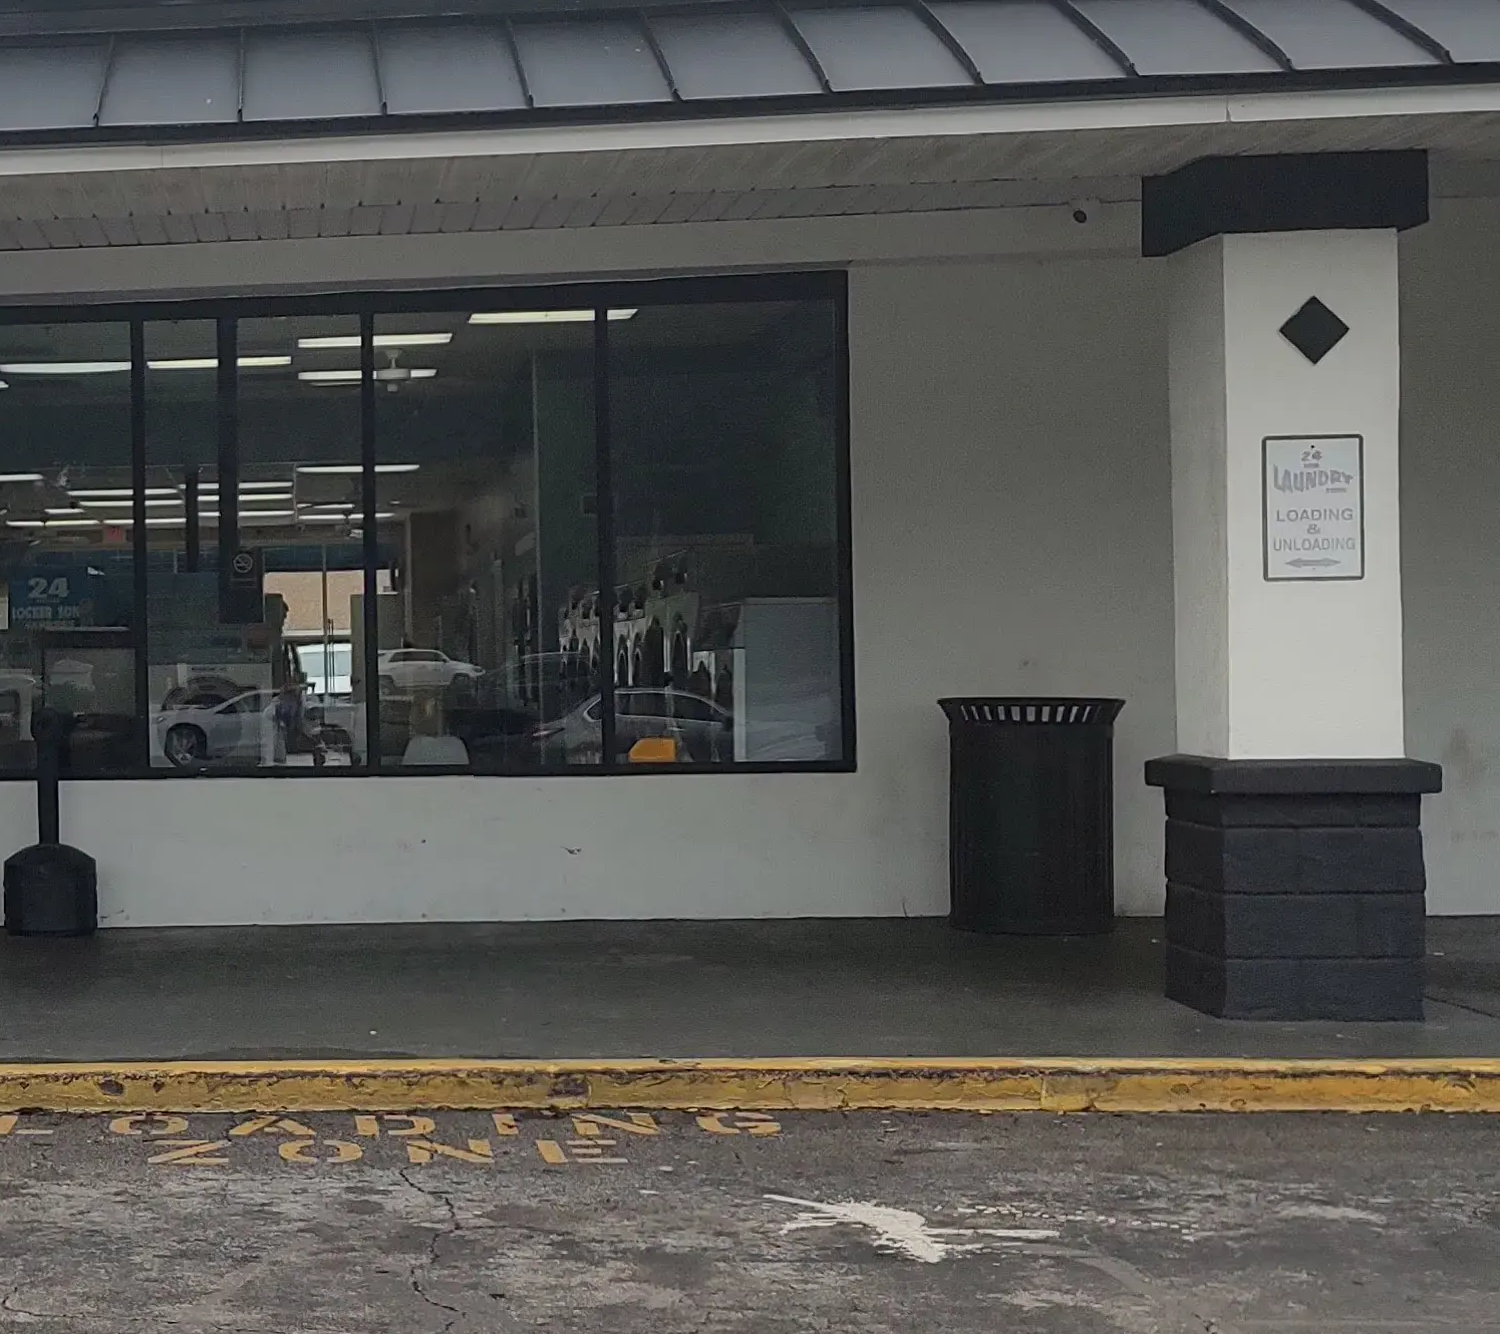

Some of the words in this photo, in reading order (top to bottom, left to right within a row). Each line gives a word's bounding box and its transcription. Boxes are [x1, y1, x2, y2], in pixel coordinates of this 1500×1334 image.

[1301, 450, 1322, 461] 24
[1273, 464, 1355, 493] LAUNDRY
[1276, 508, 1353, 522] LOADING
[1307, 524, 1320, 535] &
[1273, 537, 1356, 551] UNLOADING
[28, 576, 70, 598] 24
[147, 1137, 629, 1165] ZONE
